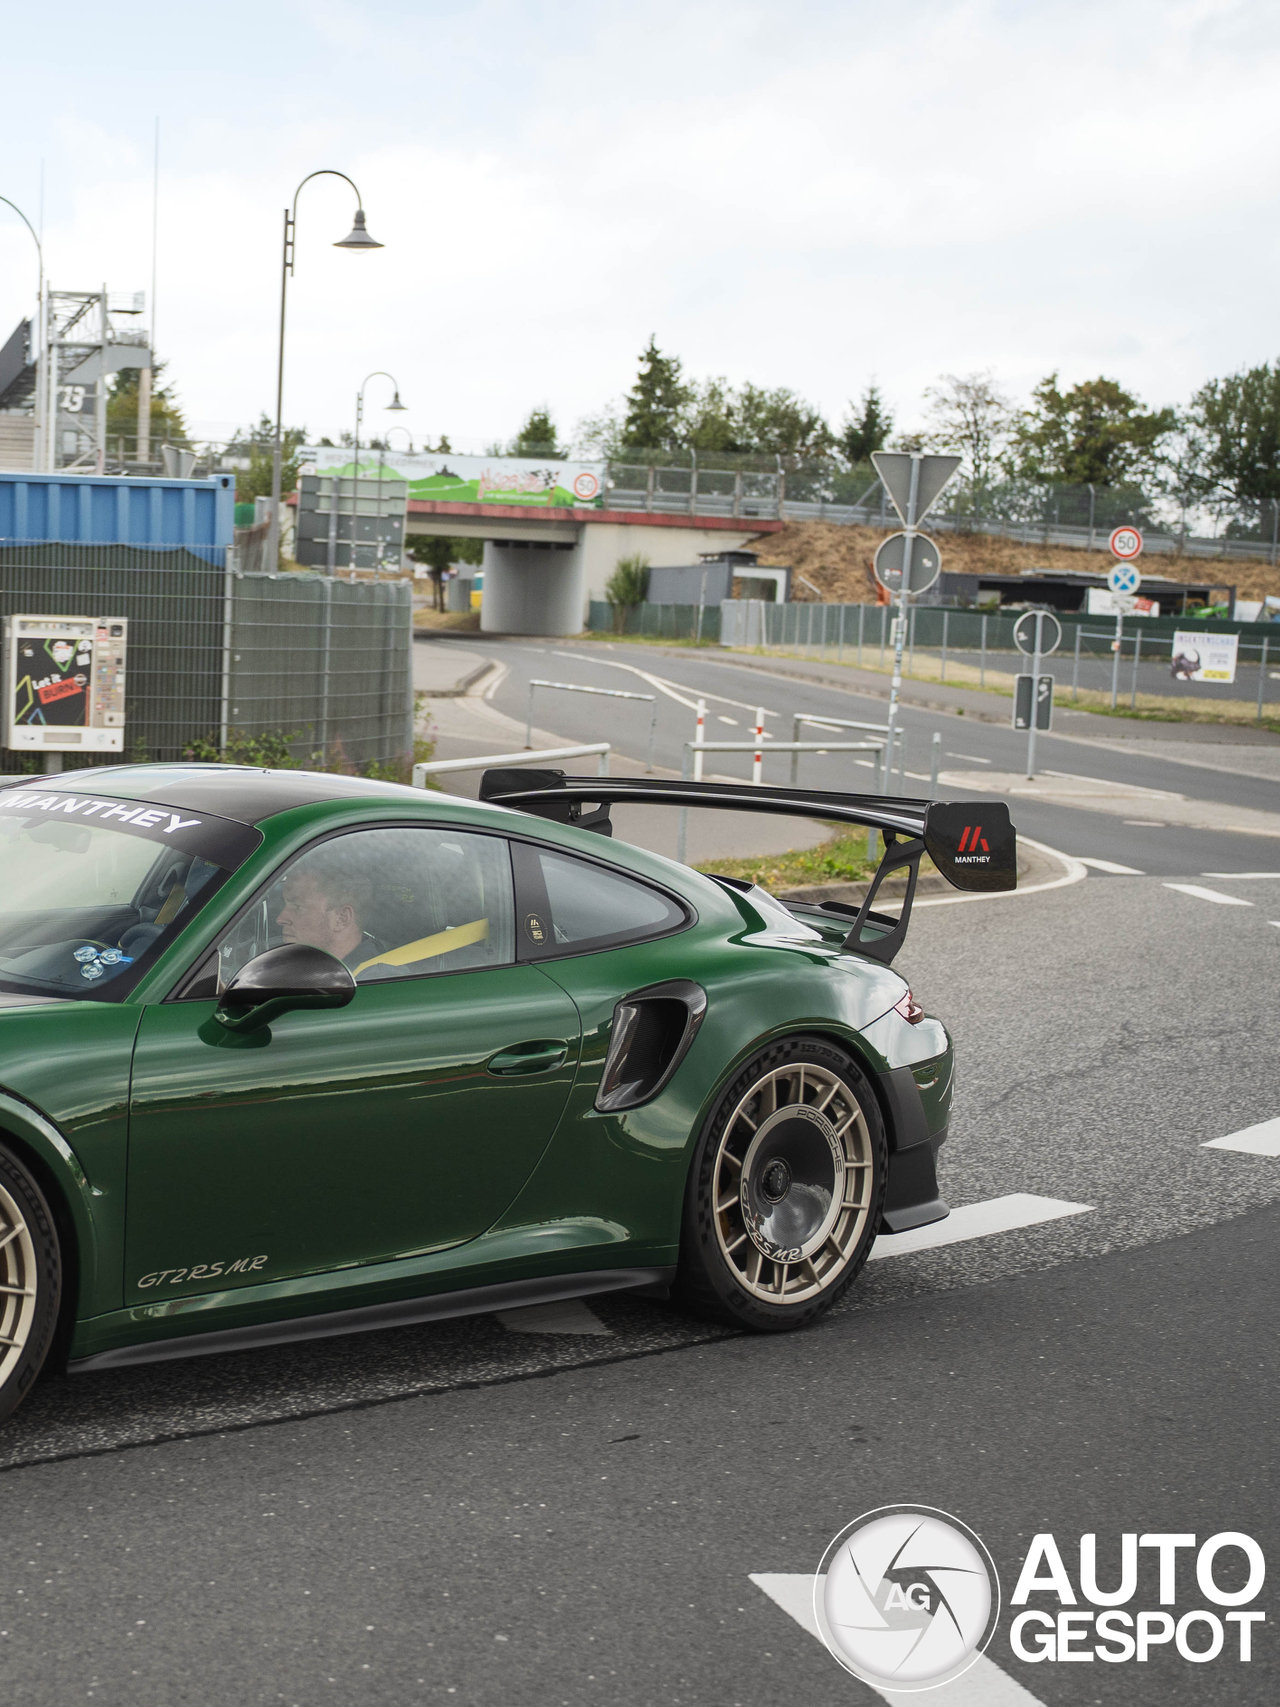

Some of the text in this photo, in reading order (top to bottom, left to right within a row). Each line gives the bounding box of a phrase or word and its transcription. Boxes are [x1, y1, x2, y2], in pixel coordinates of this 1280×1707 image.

[1118, 536, 1135, 550] 50
[954, 856, 991, 864] MANTHEY
[797, 1109, 842, 1173] PORSCHE
